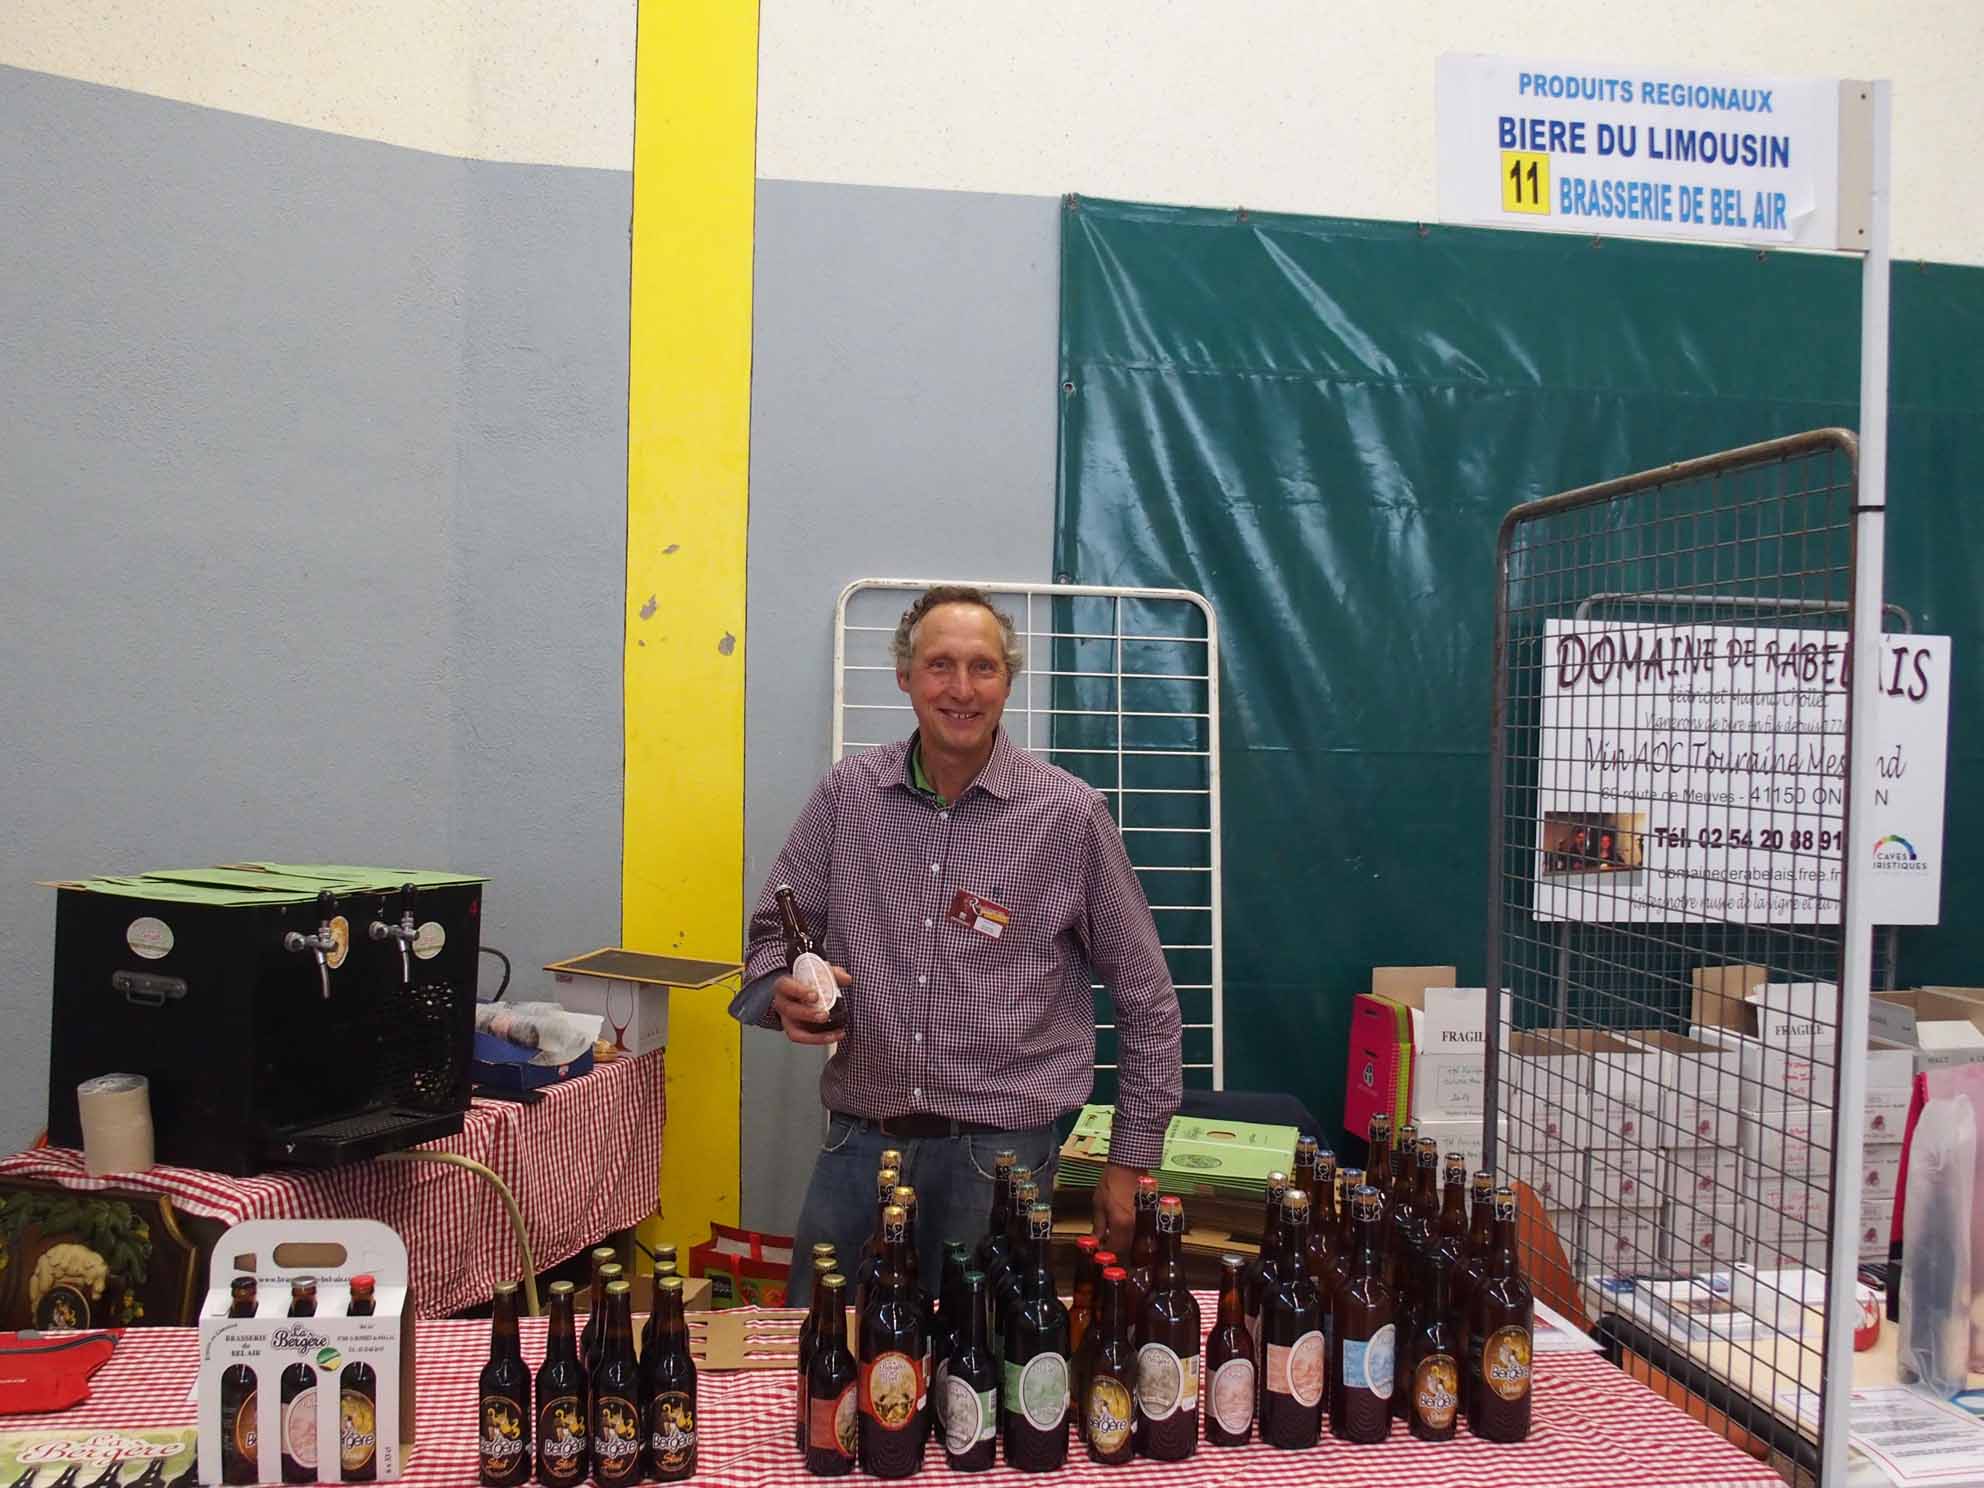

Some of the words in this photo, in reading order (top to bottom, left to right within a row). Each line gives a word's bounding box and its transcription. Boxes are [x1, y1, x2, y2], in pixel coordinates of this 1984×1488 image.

[1519, 72, 1634, 103] PRODUITS
[1641, 81, 1774, 114] REGIONAUX
[1499, 116, 1587, 155] BIERE
[1597, 122, 1637, 158] DU
[1648, 127, 1790, 169] LIMOUSIN
[1509, 158, 1540, 205] 11
[1559, 176, 1673, 224] BRASSERIE
[1679, 185, 1705, 226] DE
[1710, 187, 1748, 229] BEL
[1752, 190, 1787, 231] AIR
[1556, 631, 1718, 689] DOMAINE
[1726, 637, 1756, 669] DE
[1587, 737, 1630, 774] Vin
[1633, 741, 1684, 774] AOC
[1692, 741, 1802, 777] Touraine
[1750, 786, 1806, 804] 41150
[1698, 828, 1723, 850] 02
[1729, 829, 1753, 850] 54
[1759, 829, 1784, 850] 20
[1790, 830, 1814, 851] 88
[1819, 831, 1842, 852] 91
[1877, 852, 1907, 861] CAVES
[1442, 1030, 1487, 1042] FRAGIL
[1775, 1024, 1825, 1037] FRAGILE
[272, 1328, 328, 1355] Bergère
